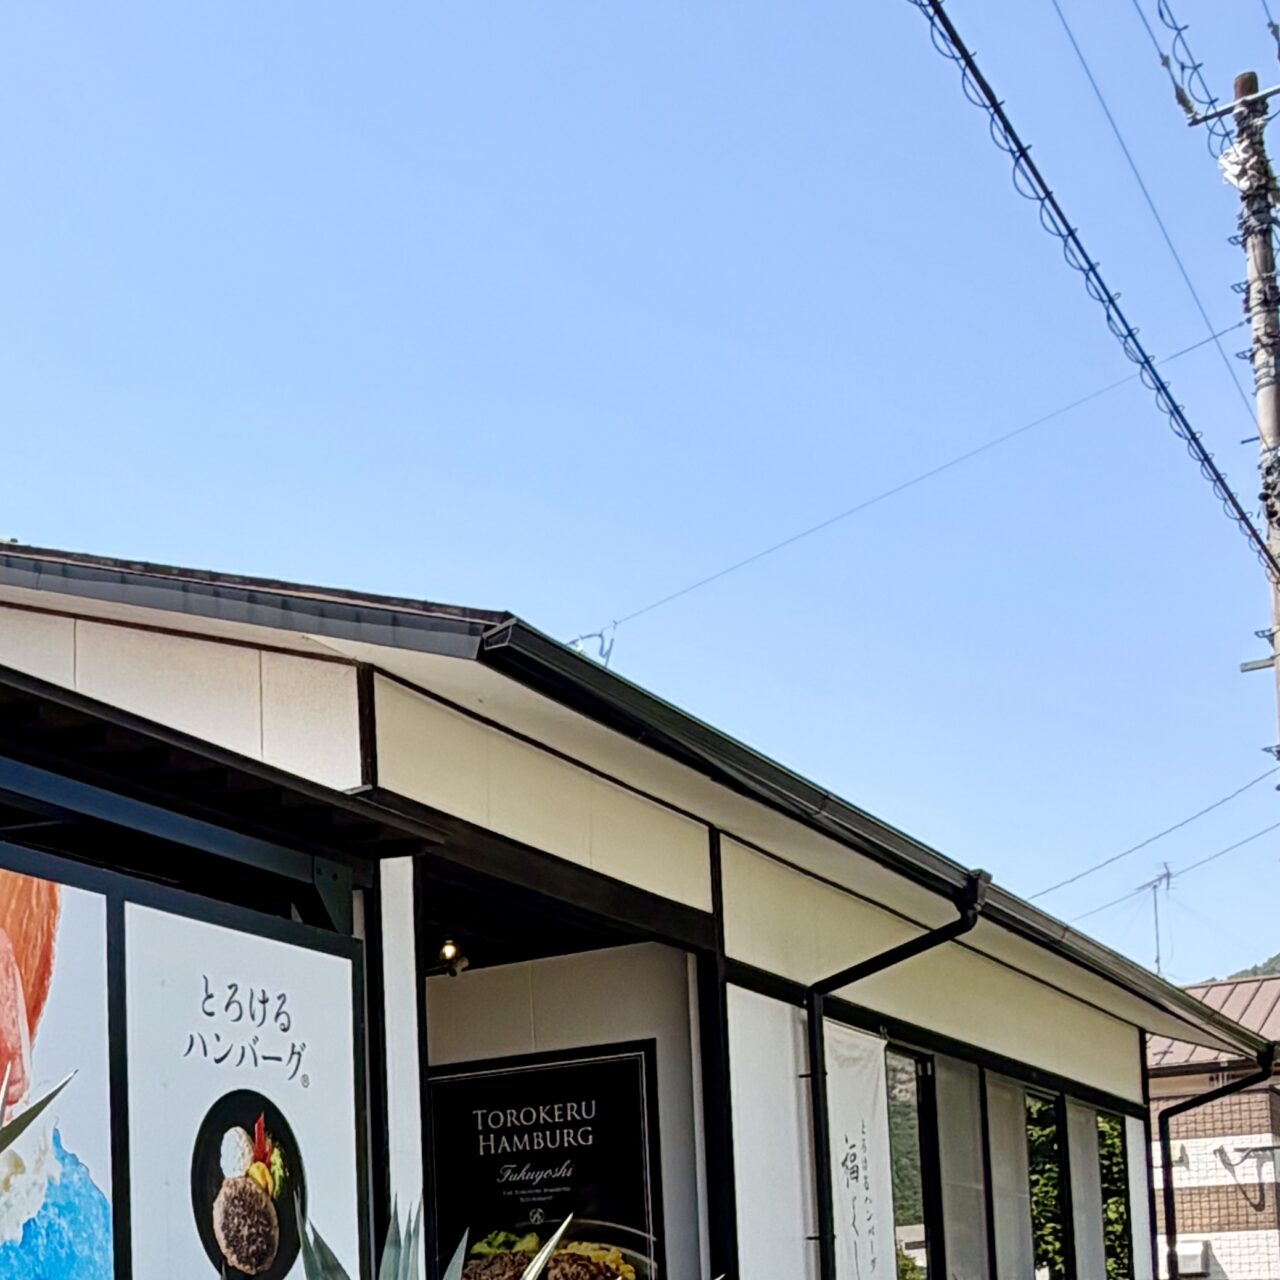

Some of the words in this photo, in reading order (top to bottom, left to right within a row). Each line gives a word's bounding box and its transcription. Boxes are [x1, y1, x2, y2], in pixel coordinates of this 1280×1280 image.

[201, 973, 292, 1033] とろける
[183, 1031, 307, 1081] ハンバーグ
[472, 1099, 597, 1131] TOROKERU
[479, 1126, 593, 1156] HAMBURG
[496, 1159, 575, 1186] Fukuyoshi
